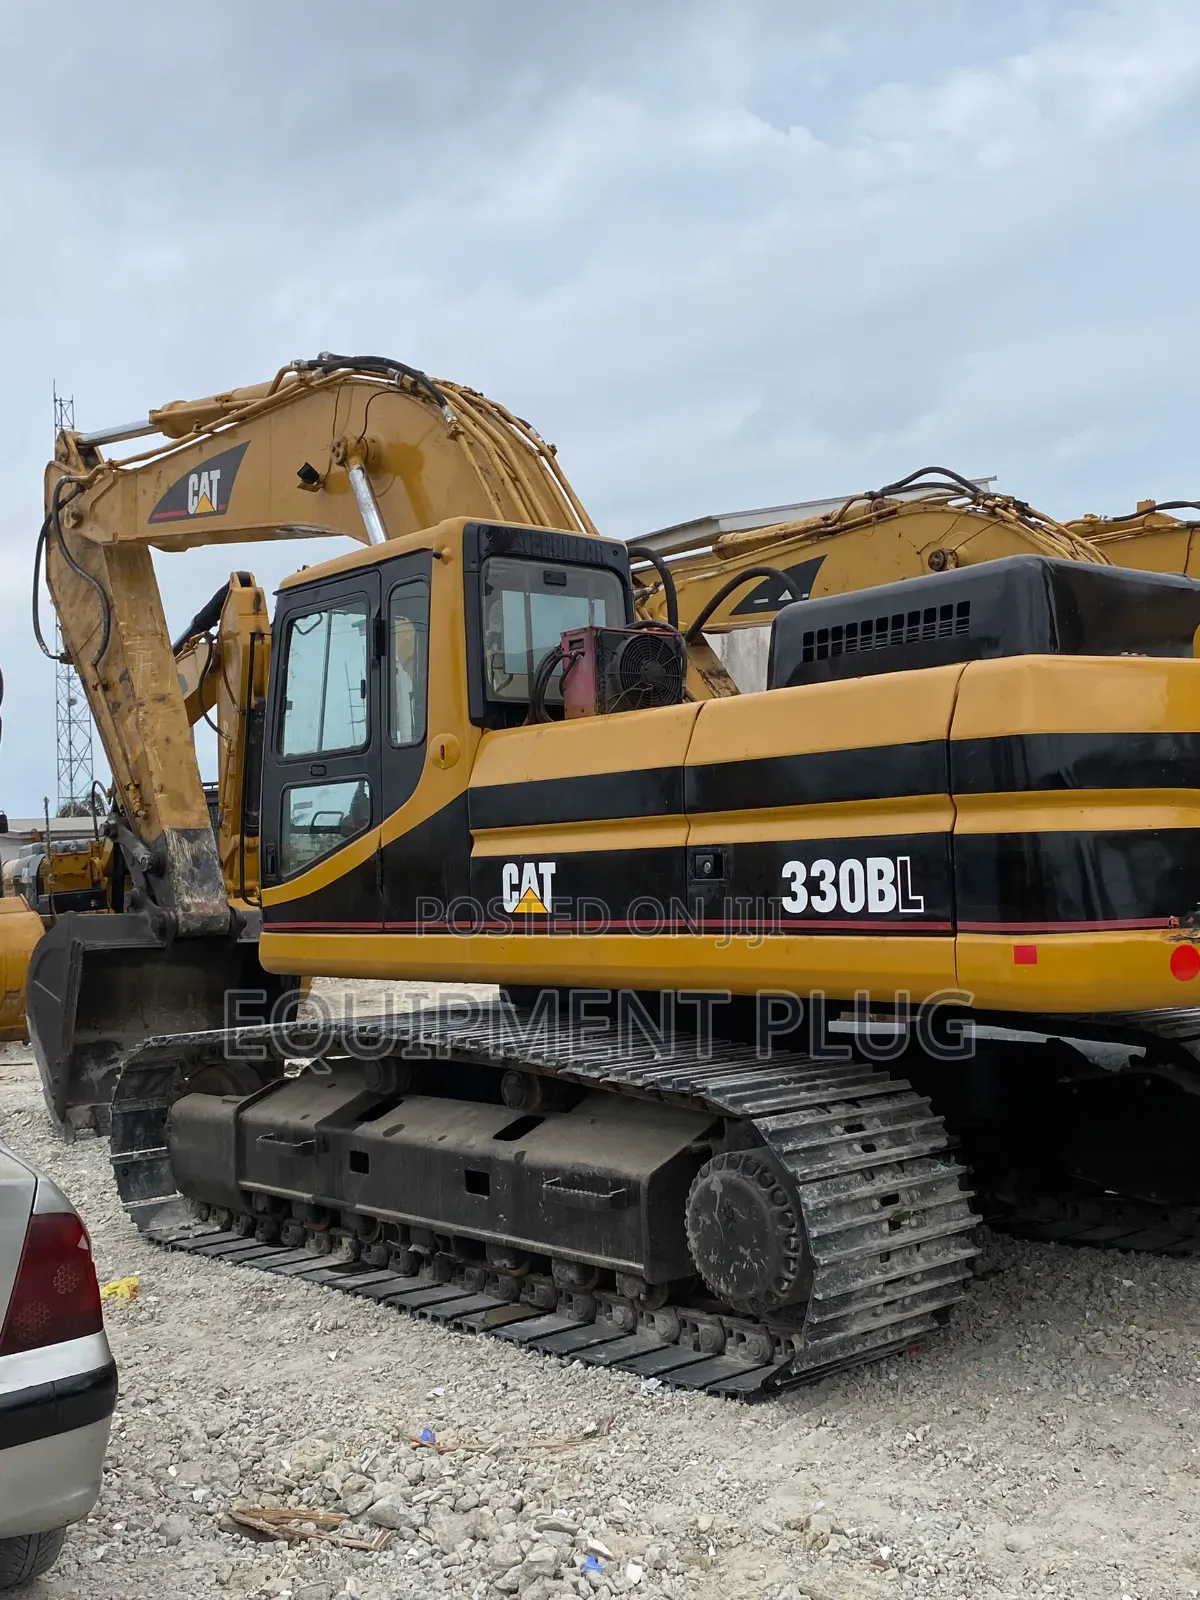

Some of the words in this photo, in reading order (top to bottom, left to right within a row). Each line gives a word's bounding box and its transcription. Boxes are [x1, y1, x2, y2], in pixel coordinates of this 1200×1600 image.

[187, 469, 221, 515] CAT
[501, 527, 606, 564] TERPILLAR
[502, 862, 556, 913] CAT
[781, 856, 924, 913] 330BL
